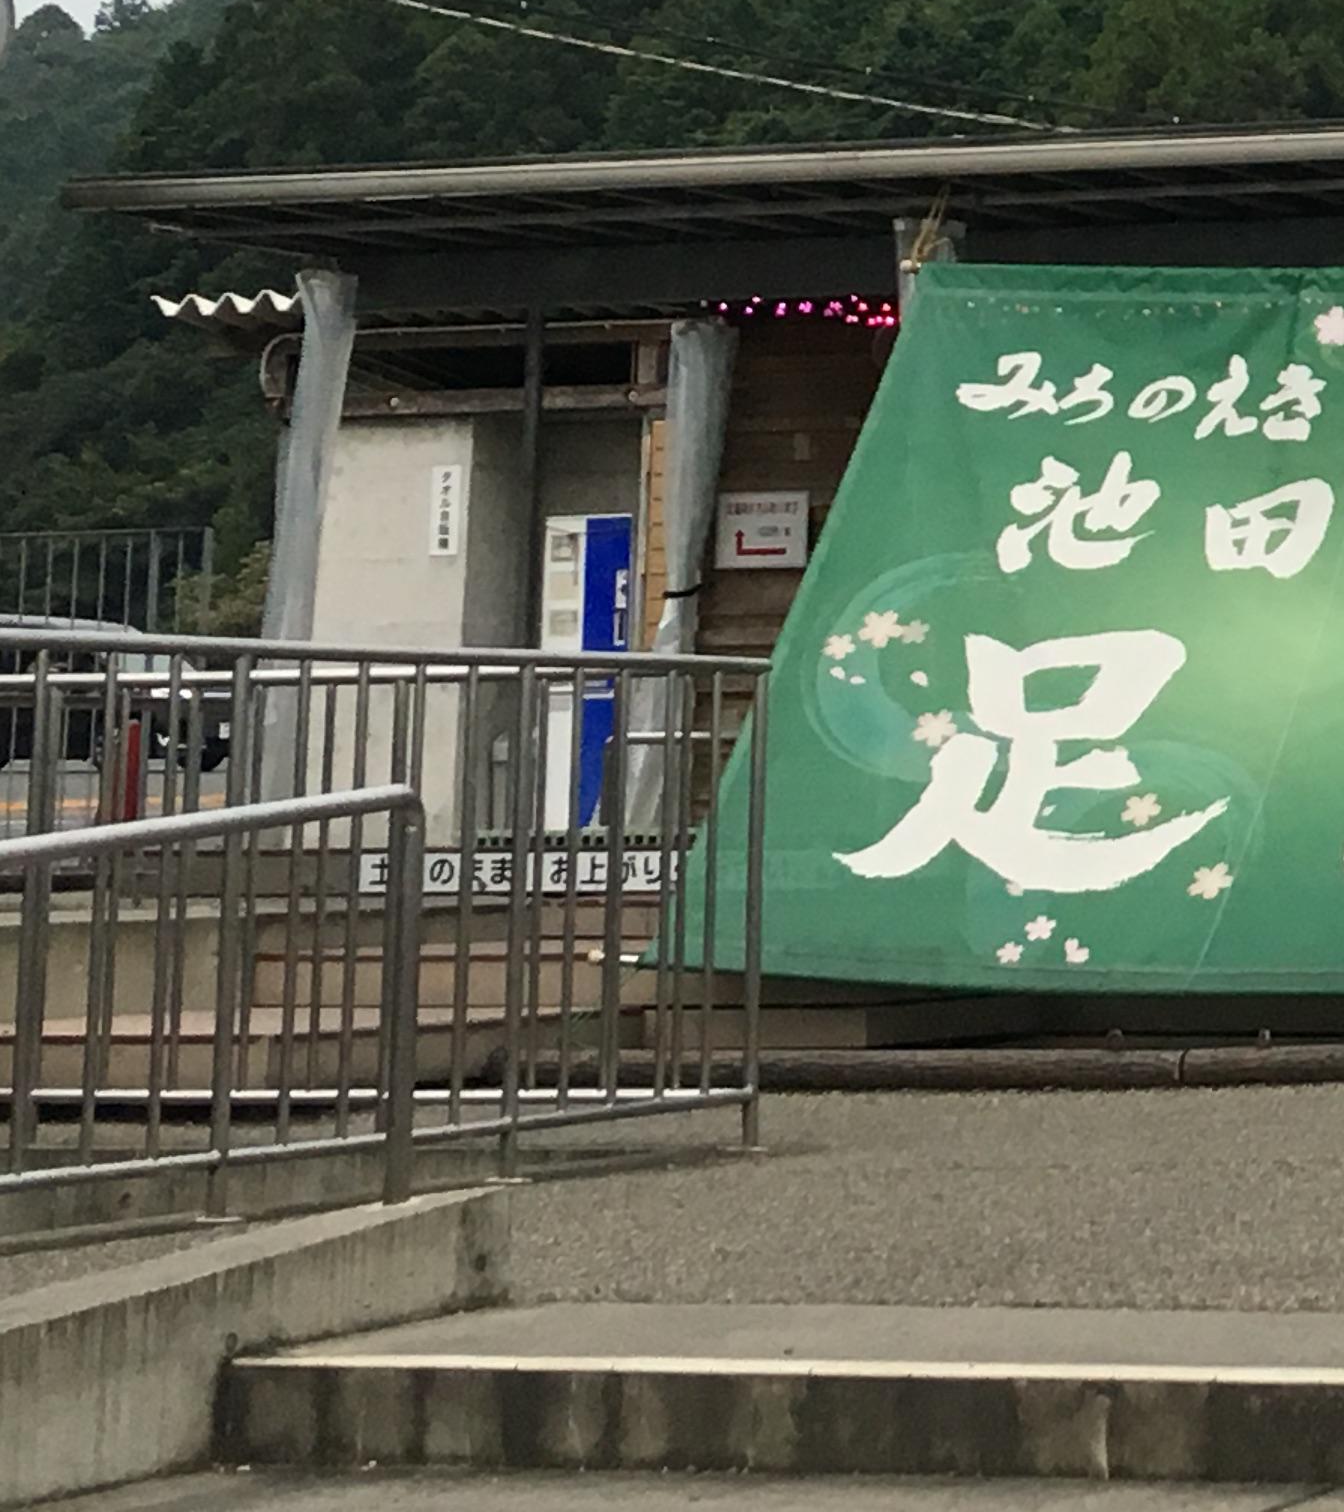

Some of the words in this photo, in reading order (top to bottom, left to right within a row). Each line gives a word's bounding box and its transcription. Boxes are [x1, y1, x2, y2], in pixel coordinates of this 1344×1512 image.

[955, 348, 1327, 441] みちのえき
